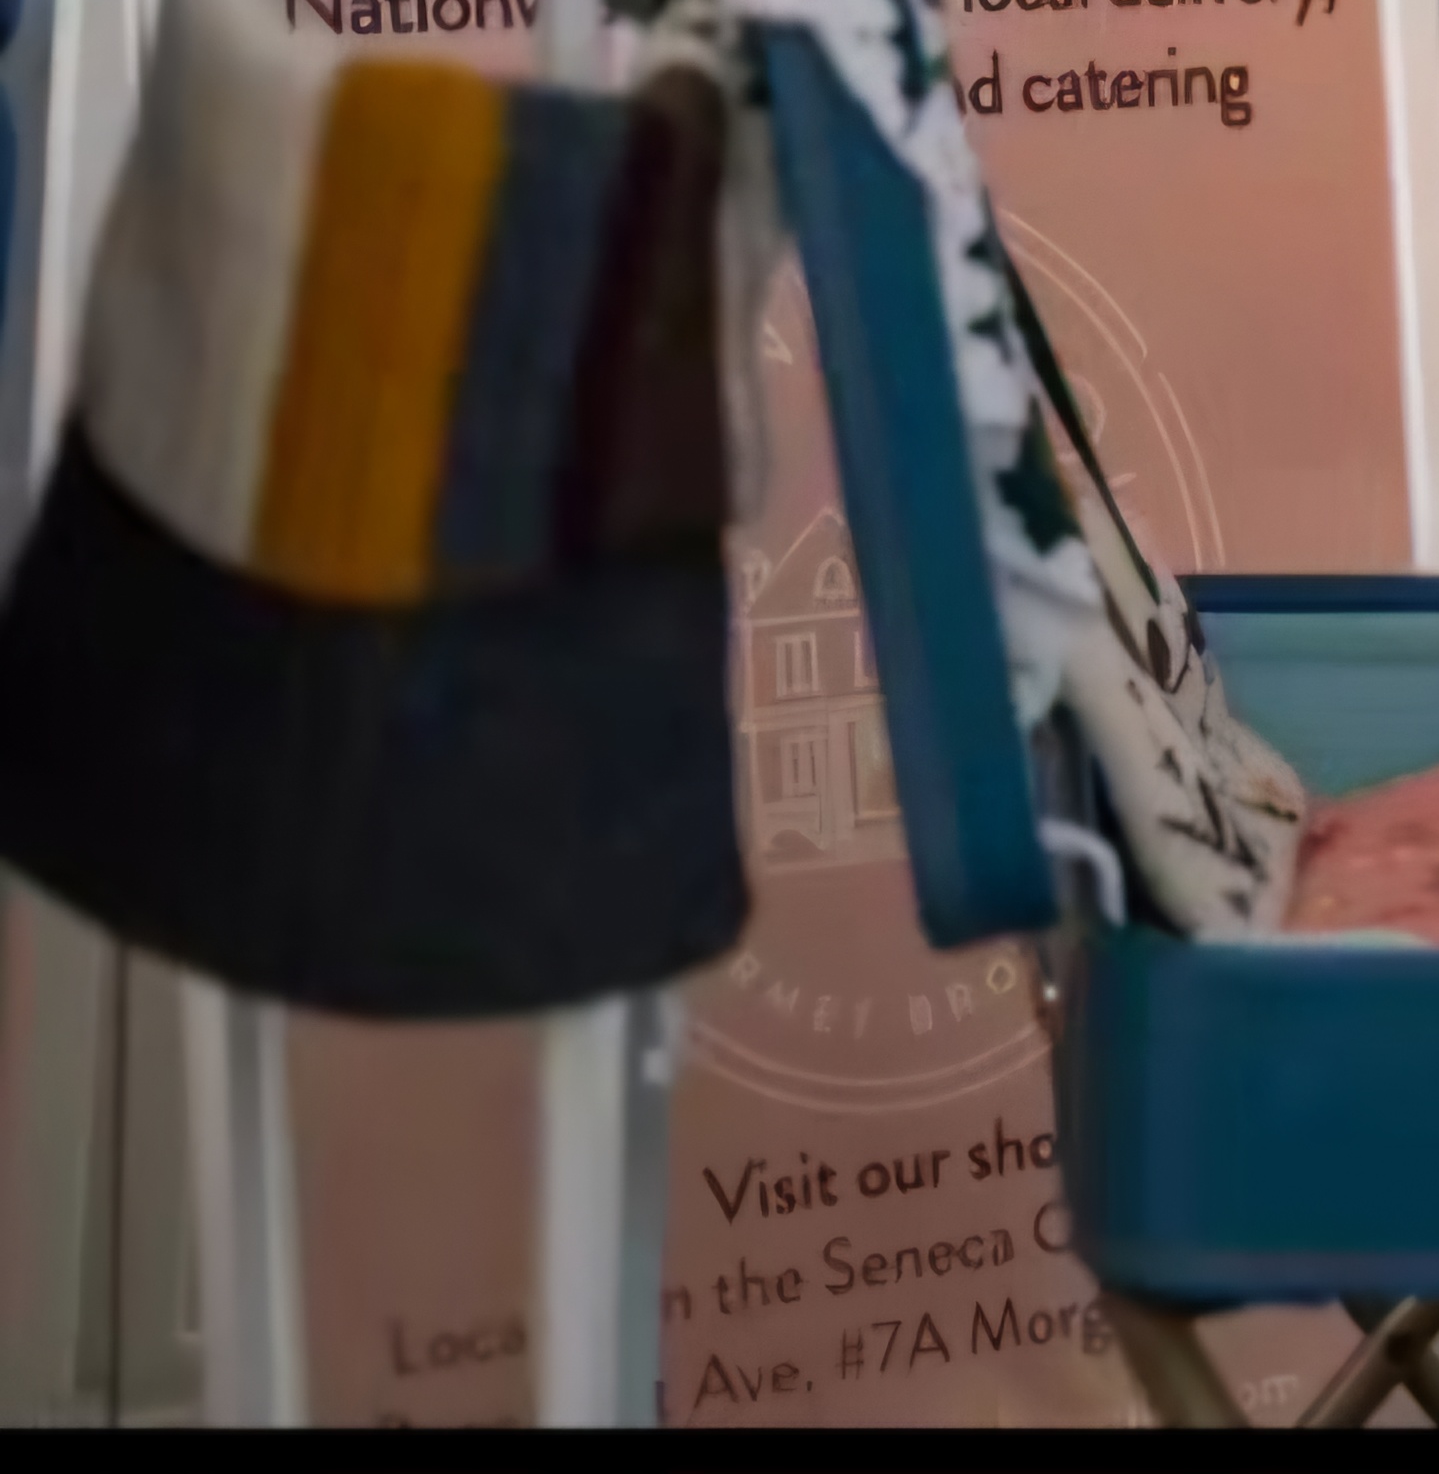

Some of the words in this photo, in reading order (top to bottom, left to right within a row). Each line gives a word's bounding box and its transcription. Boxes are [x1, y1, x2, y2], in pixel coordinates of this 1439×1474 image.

[1022, 46, 1252, 126] catering
[702, 1150, 838, 1225] Visit
[856, 1150, 950, 1196] our
[713, 1256, 804, 1315] the
[823, 1229, 1015, 1295] Seneca
[836, 1312, 951, 1380] #7A
